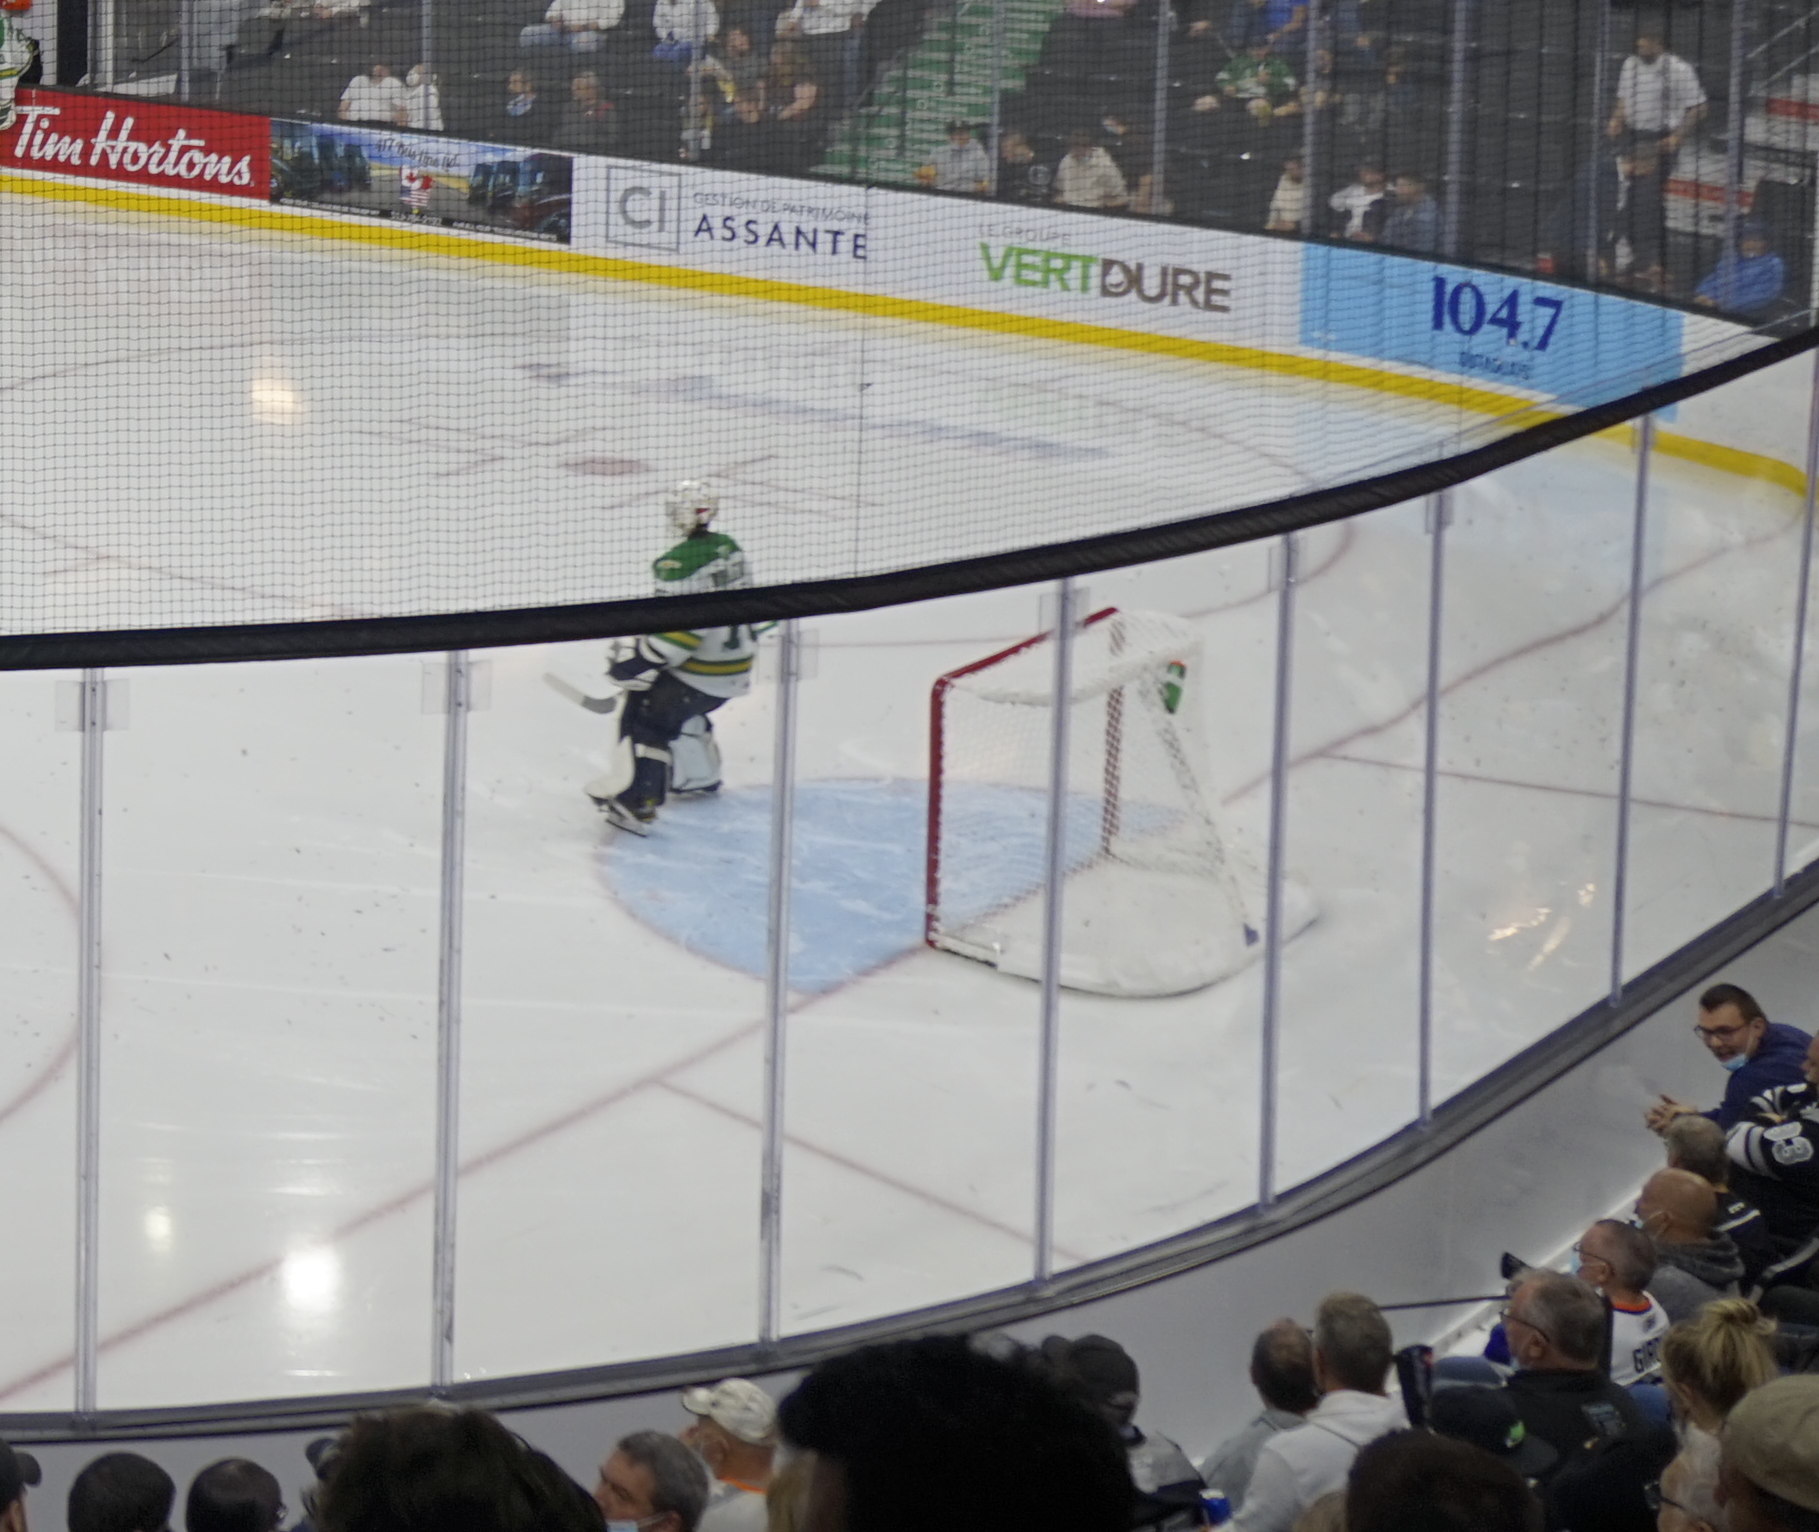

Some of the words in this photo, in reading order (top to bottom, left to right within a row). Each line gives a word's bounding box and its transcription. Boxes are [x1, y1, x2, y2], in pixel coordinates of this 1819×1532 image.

[15, 105, 84, 166] Tim
[90, 110, 252, 187] Hortons
[619, 185, 667, 233] CI
[693, 214, 868, 262] ASSANTE
[997, 225, 1072, 247] GROUPE
[979, 241, 1232, 314] VERTDURE
[1432, 275, 1564, 352] 104.7
